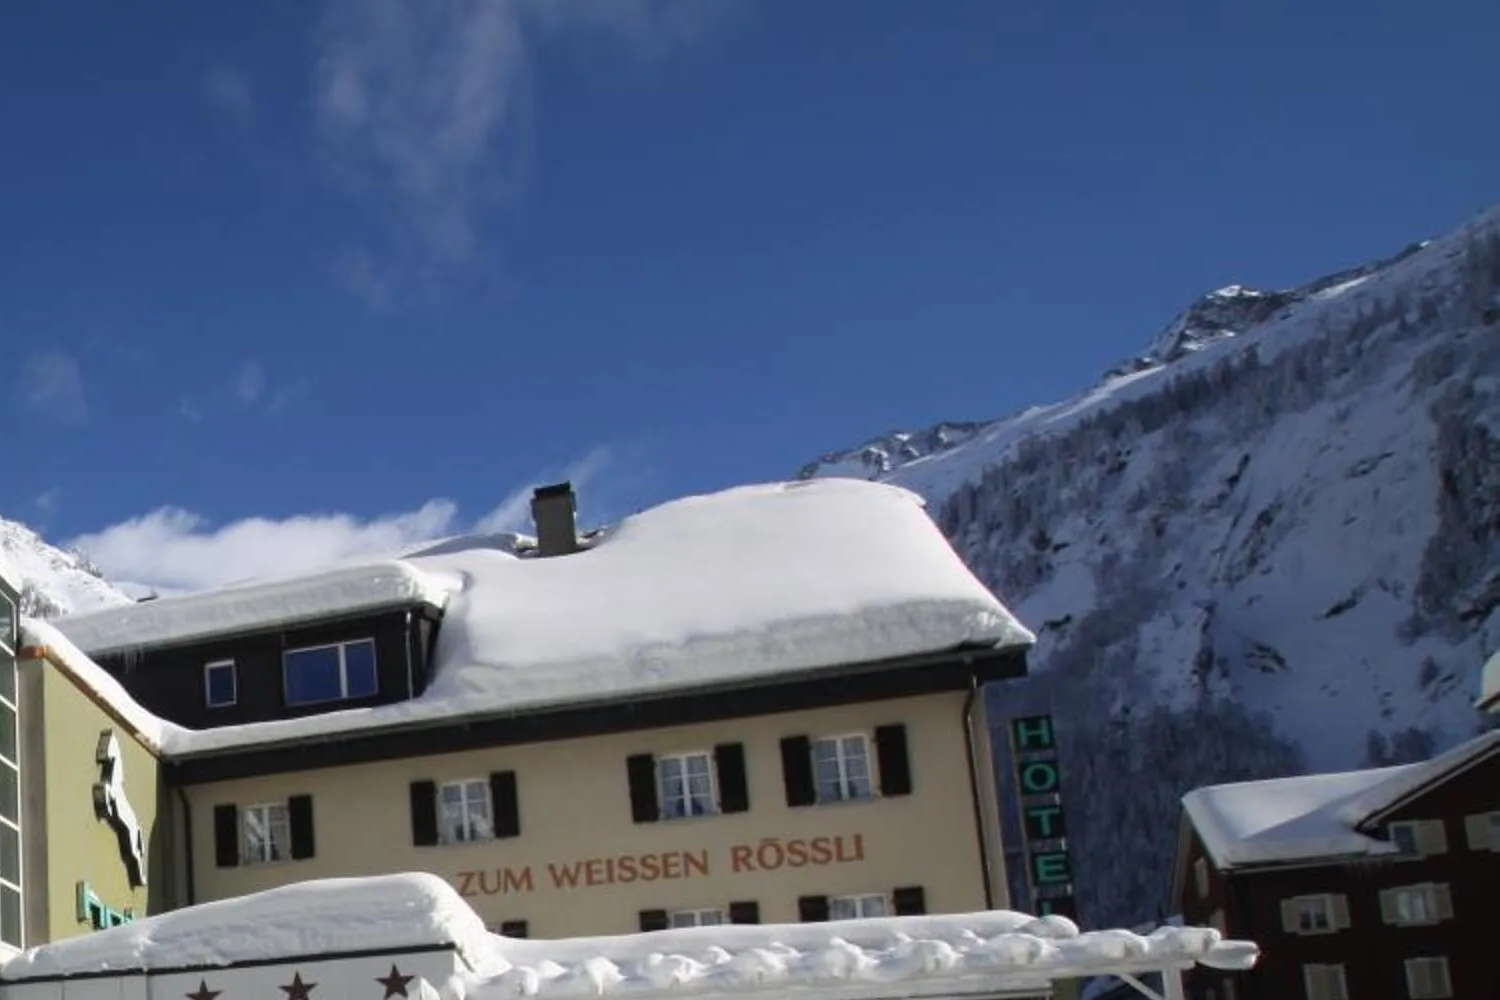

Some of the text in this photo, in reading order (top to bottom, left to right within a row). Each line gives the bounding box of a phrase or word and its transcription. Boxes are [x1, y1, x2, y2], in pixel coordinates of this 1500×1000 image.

[456, 832, 865, 897] ZUM WEISSEN RÖSSLI
